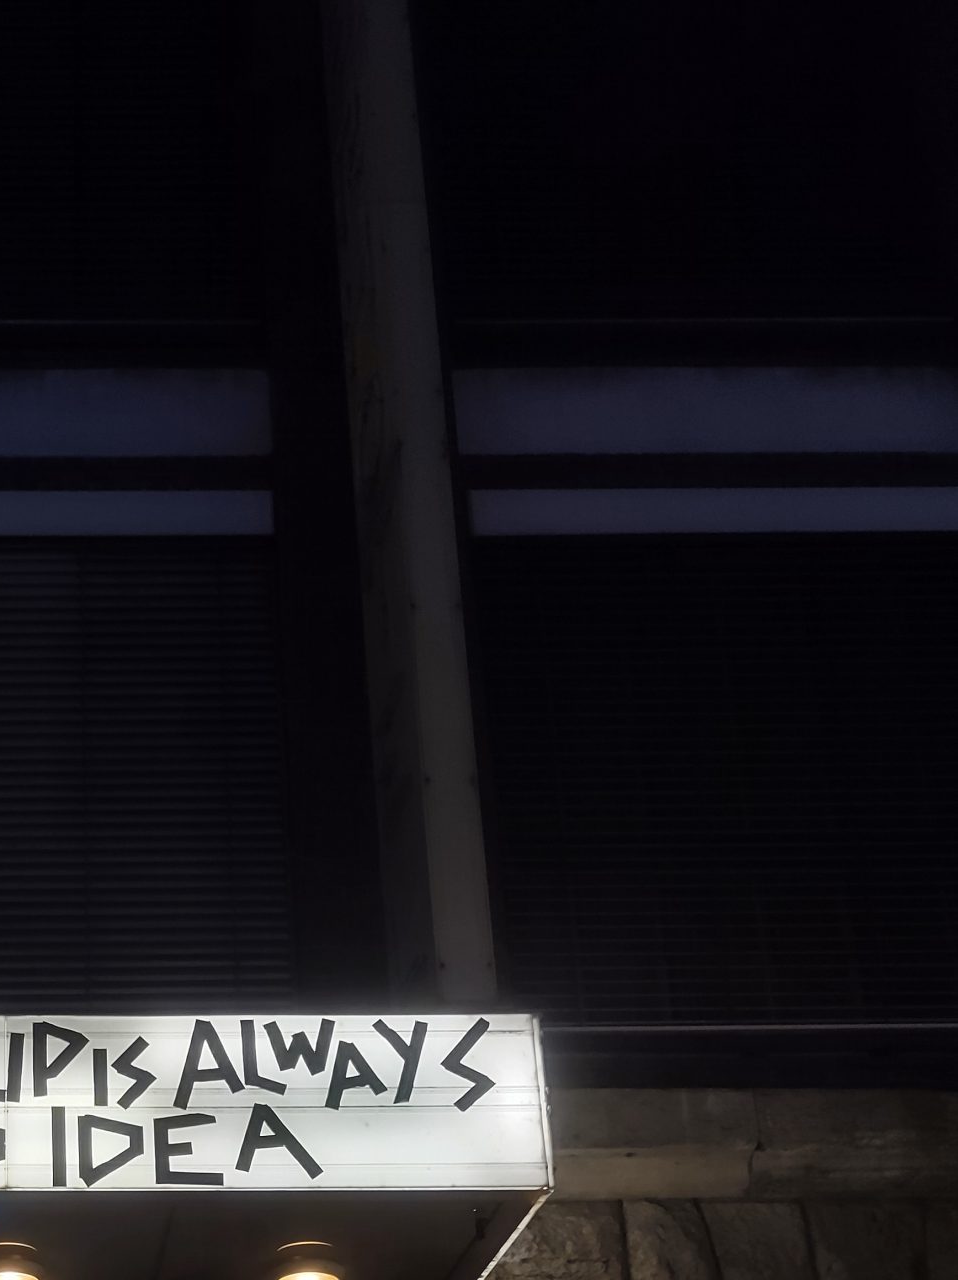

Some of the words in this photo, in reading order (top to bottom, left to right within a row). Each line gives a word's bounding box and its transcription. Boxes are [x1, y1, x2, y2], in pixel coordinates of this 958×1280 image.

[93, 1036, 158, 1109] IS
[173, 1018, 497, 1111] ALWAYS
[51, 1103, 324, 1187] IDEA
